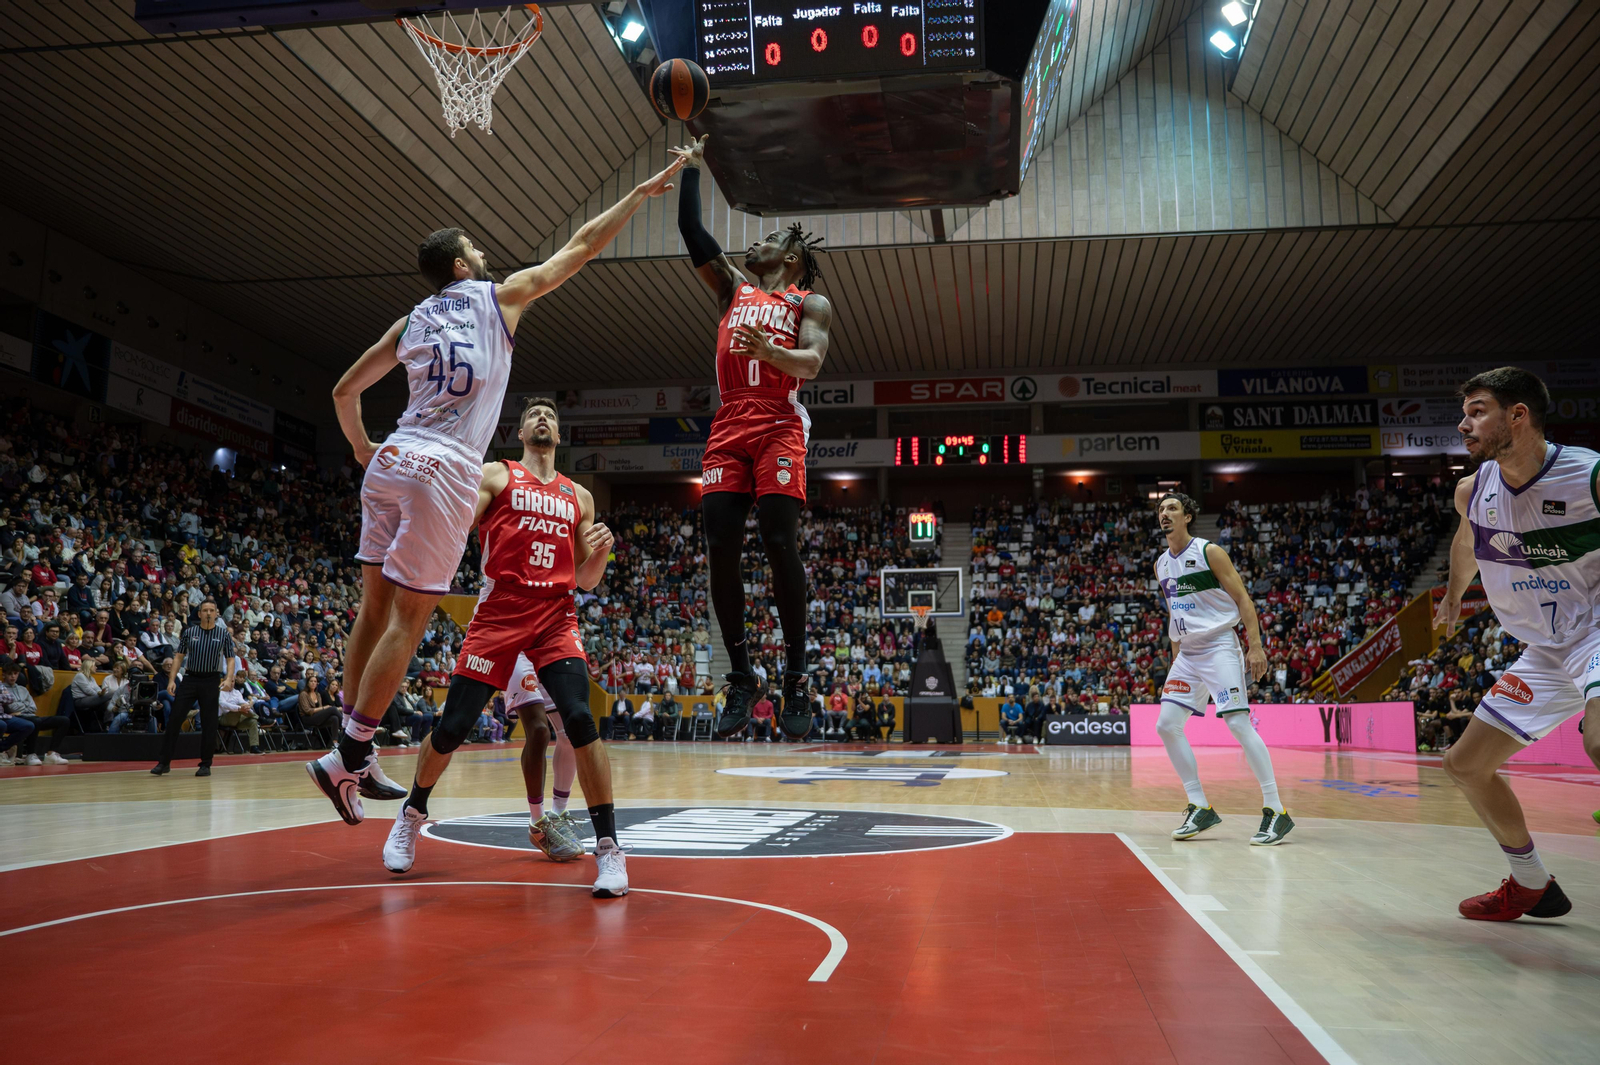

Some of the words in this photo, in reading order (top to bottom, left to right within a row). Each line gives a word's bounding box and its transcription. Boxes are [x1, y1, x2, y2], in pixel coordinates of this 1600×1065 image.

[793, 5, 841, 20] Jugador
[854, 3, 882, 14] Falta
[891, 6, 919, 18] Falta
[754, 15, 783, 28] Falta
[810, 28, 827, 52] 0
[861, 25, 879, 48] 0
[900, 33, 917, 57] 0
[765, 42, 781, 65] 0
[426, 296, 470, 319] KRAVISH
[727, 305, 798, 335] GIRONA
[427, 341, 474, 397] 45
[748, 359, 760, 387] 0
[1271, 370, 1313, 378] CATERING
[1403, 368, 1416, 376] Bo
[910, 382, 1003, 400] SPAR
[1082, 376, 1171, 396] Tecnical
[1172, 384, 1203, 394] meat
[1241, 376, 1344, 394] VILANOVA
[1404, 379, 1417, 387] Bo
[583, 398, 631, 408] FRISELVA
[799, 383, 854, 405] nical
[1233, 406, 1285, 427] SANT
[1293, 404, 1372, 425] DALMAI
[1382, 416, 1421, 424] VALENT
[176, 406, 269, 455] diaridegirona.cat
[939, 445, 945, 454] 0
[946, 436, 974, 446] 09:45
[982, 444, 989, 453] 0
[1079, 434, 1160, 458] parlem
[1233, 445, 1272, 453] Viñolas
[405, 451, 440, 471] COSTA
[663, 446, 705, 459] Estanys
[935, 456, 943, 465] 0
[979, 455, 987, 464] 0
[400, 459, 414, 469] DEL
[417, 464, 436, 479] SOL
[682, 458, 704, 470] Bla
[511, 488, 575, 523] GIRONA
[517, 516, 570, 538] FIATC
[528, 541, 556, 569] 35
[1520, 544, 1569, 558] Unicaja
[1512, 574, 1571, 594] málaga
[1171, 602, 1196, 611] álaga
[1174, 618, 1187, 636] 14
[1540, 601, 1557, 635] 7
[465, 654, 496, 676] YOSOY
[1496, 680, 1531, 702] amadesa
[1049, 718, 1127, 735] endesa
